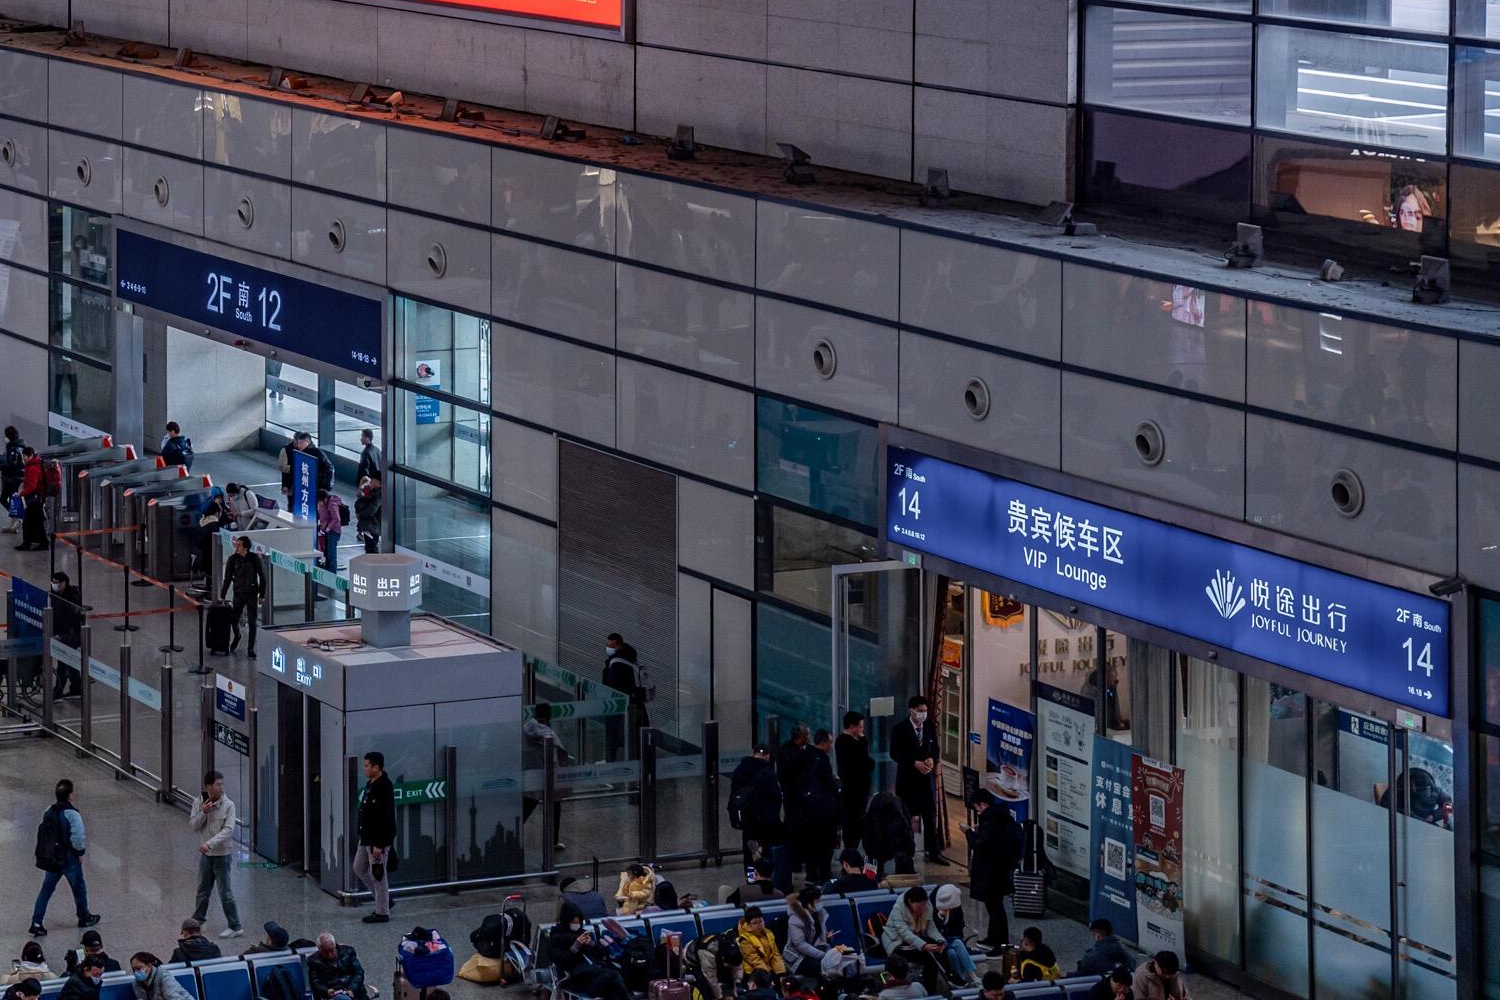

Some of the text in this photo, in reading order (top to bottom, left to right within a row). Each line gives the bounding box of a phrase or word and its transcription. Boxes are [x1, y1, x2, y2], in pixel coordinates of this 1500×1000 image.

[206, 272, 282, 332] 2F 南 12
[235, 307, 253, 323] South
[894, 463, 926, 483] 2F 南 South
[898, 487, 921, 520] 14
[1007, 499, 1124, 565] 贵宾候车区
[1023, 547, 1107, 590] VIP Lounge
[353, 573, 367, 587] 出口
[377, 578, 399, 589] 出口
[410, 573, 419, 587] 出口
[353, 587, 367, 595] EXIT
[410, 586, 420, 595] EXIT
[1250, 578, 1348, 633] 悦途出行
[1396, 608, 1442, 633] 2F 南 South
[1251, 613, 1348, 654] JOYFUL JOURNEY
[1402, 637, 1434, 677] 14
[296, 671, 312, 686] EXIT
[406, 789, 423, 798] EXIT
